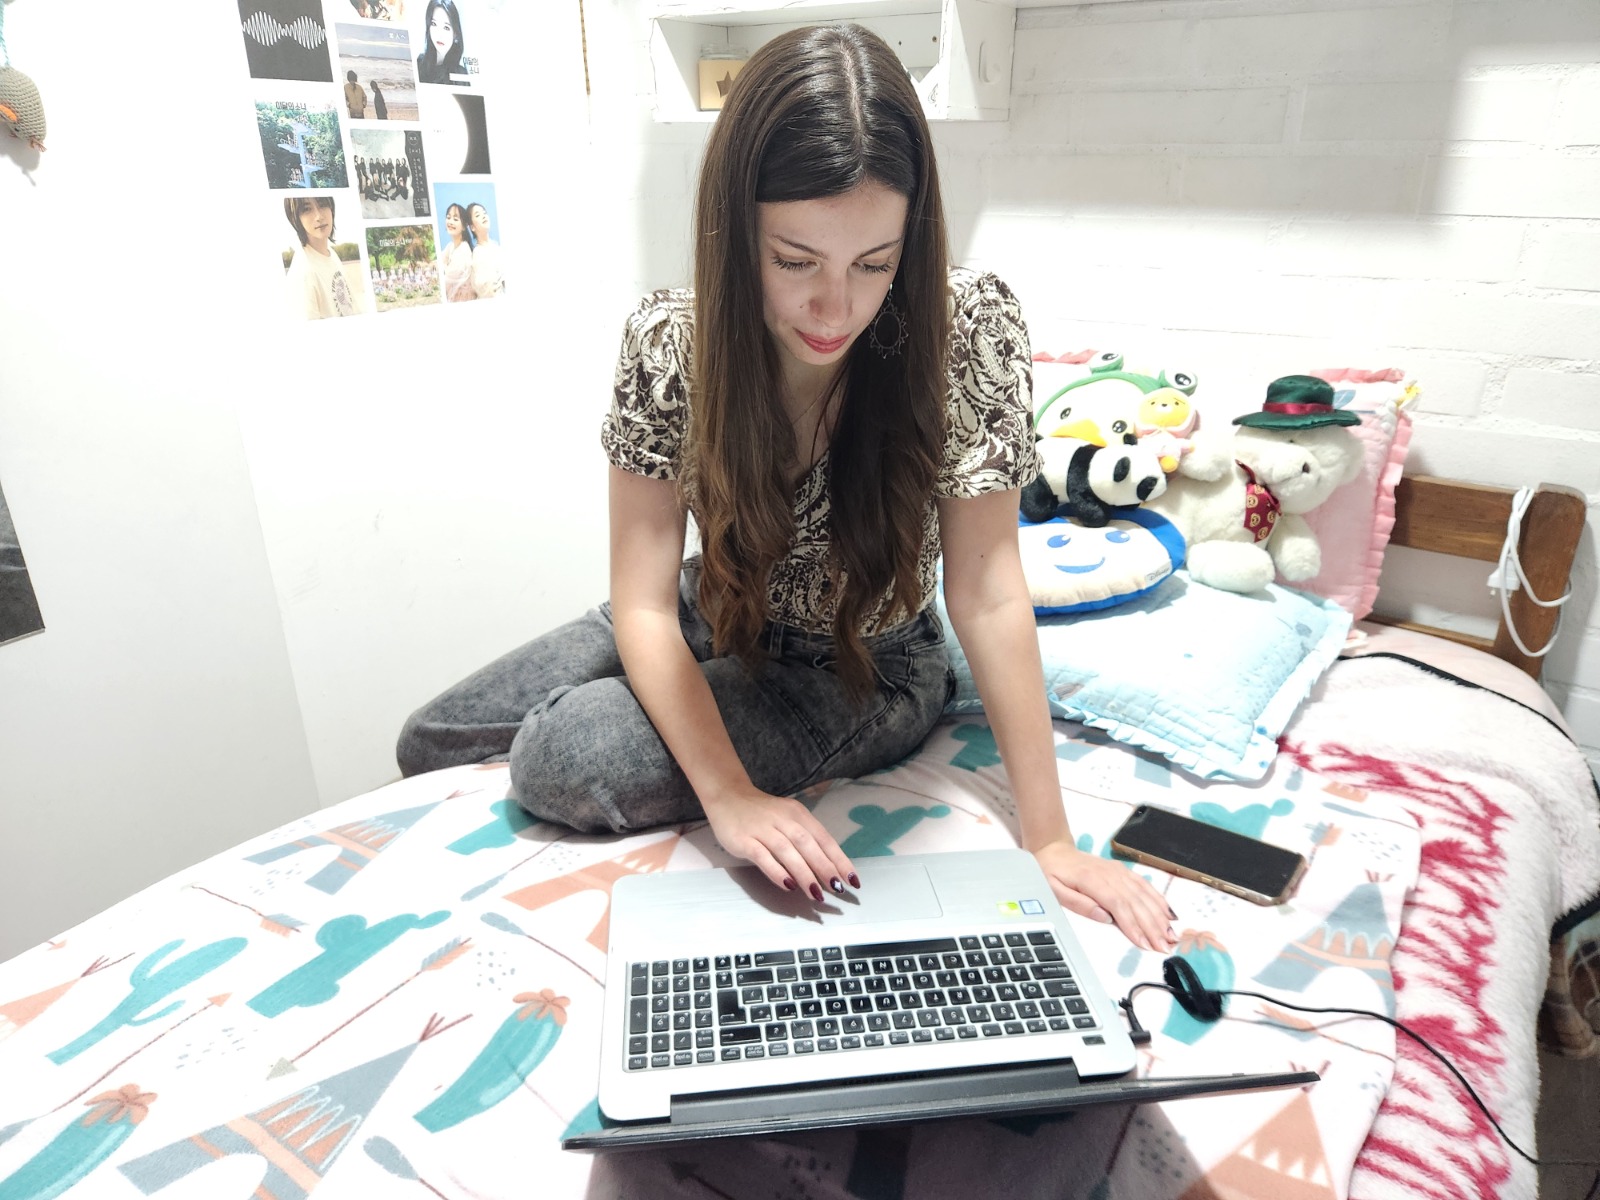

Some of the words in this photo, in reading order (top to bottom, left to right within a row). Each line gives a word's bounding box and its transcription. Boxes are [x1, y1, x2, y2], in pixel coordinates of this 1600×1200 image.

[677, 961, 684, 969] 0
[855, 963, 863, 971] M
[879, 961, 887, 969] N
[920, 975, 928, 983] G
[968, 972, 975, 980] D
[896, 977, 903, 985] H
[848, 981, 855, 990] K
[1004, 987, 1014, 995] W
[1028, 986, 1037, 994] Q
[956, 991, 963, 999] R
[678, 997, 685, 1005] 5
[808, 1004, 815, 1012] P
[832, 1002, 841, 1010] O
[876, 1017, 882, 1025] 8
[925, 1013, 932, 1021] 6
[657, 1018, 664, 1026] 9
